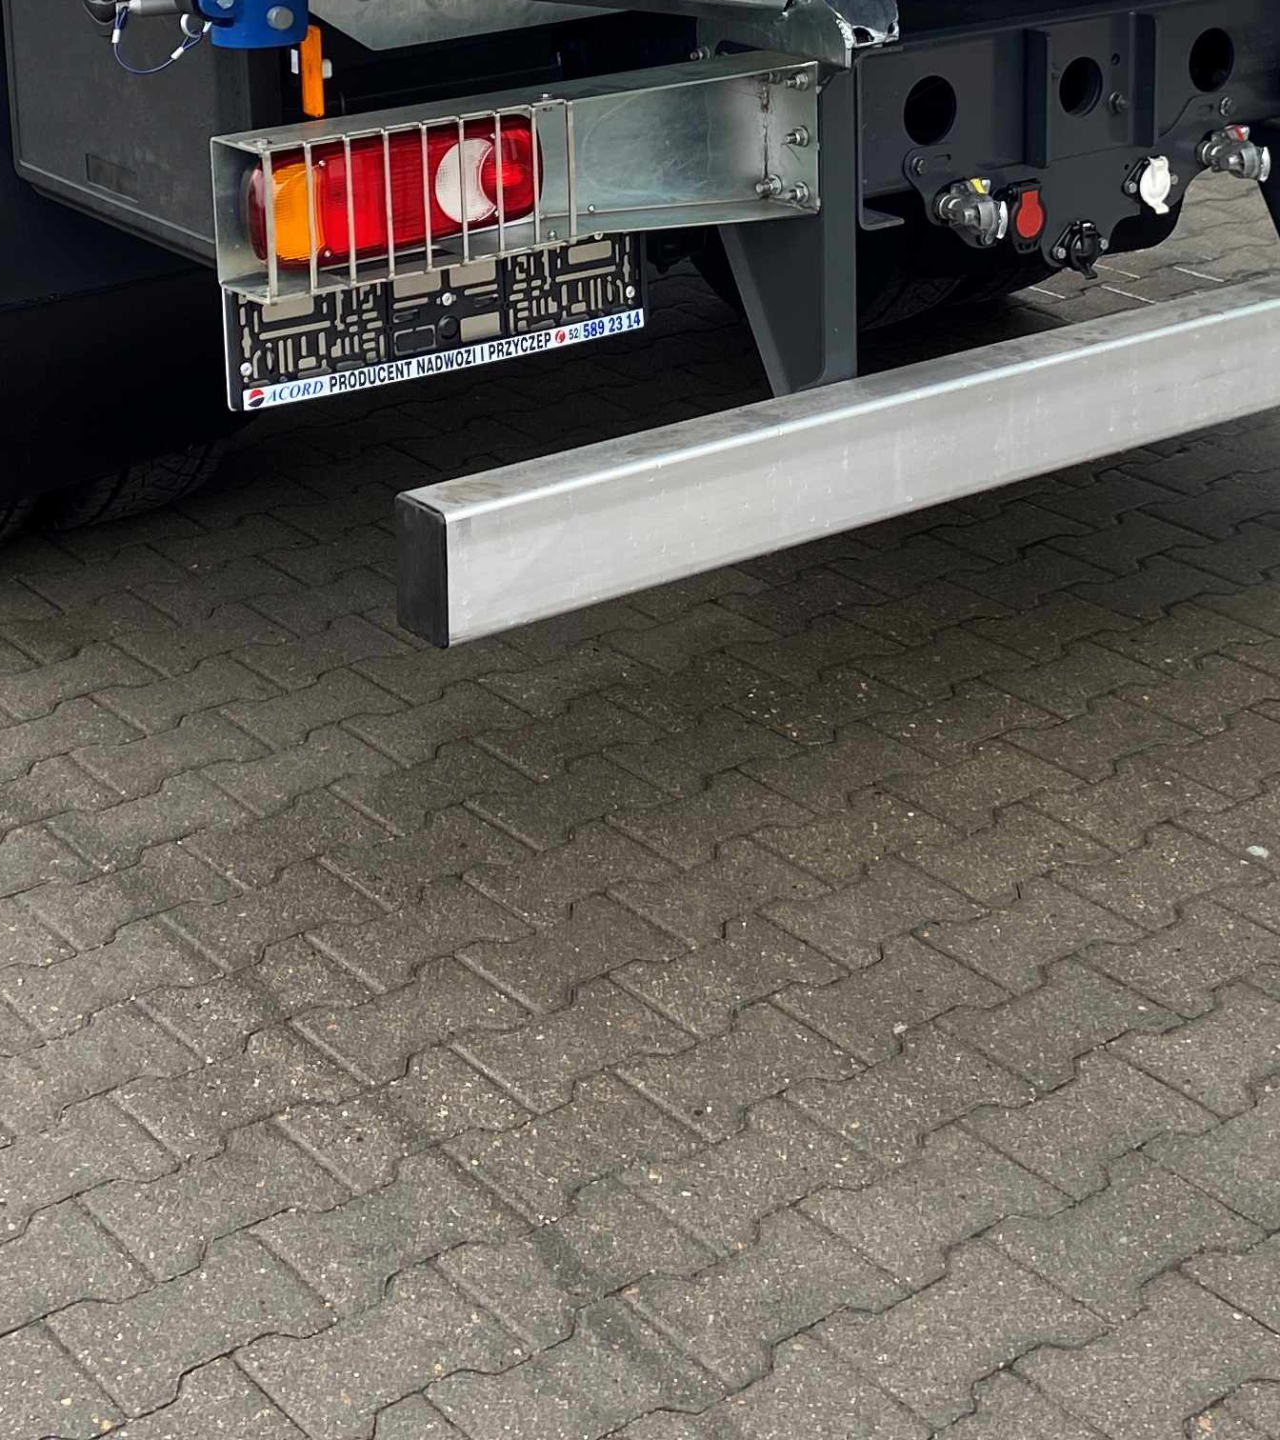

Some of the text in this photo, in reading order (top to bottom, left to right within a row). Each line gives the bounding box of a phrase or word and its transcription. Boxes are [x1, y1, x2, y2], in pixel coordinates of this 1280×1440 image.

[267, 380, 324, 403] ACORD
[329, 361, 412, 393] PRODUCENT
[416, 348, 476, 375] NADWOZI
[480, 347, 485, 362] I
[488, 332, 552, 359] PRZYCZEP
[583, 319, 605, 338] 589
[608, 315, 623, 333] 23
[627, 311, 641, 328] 14
